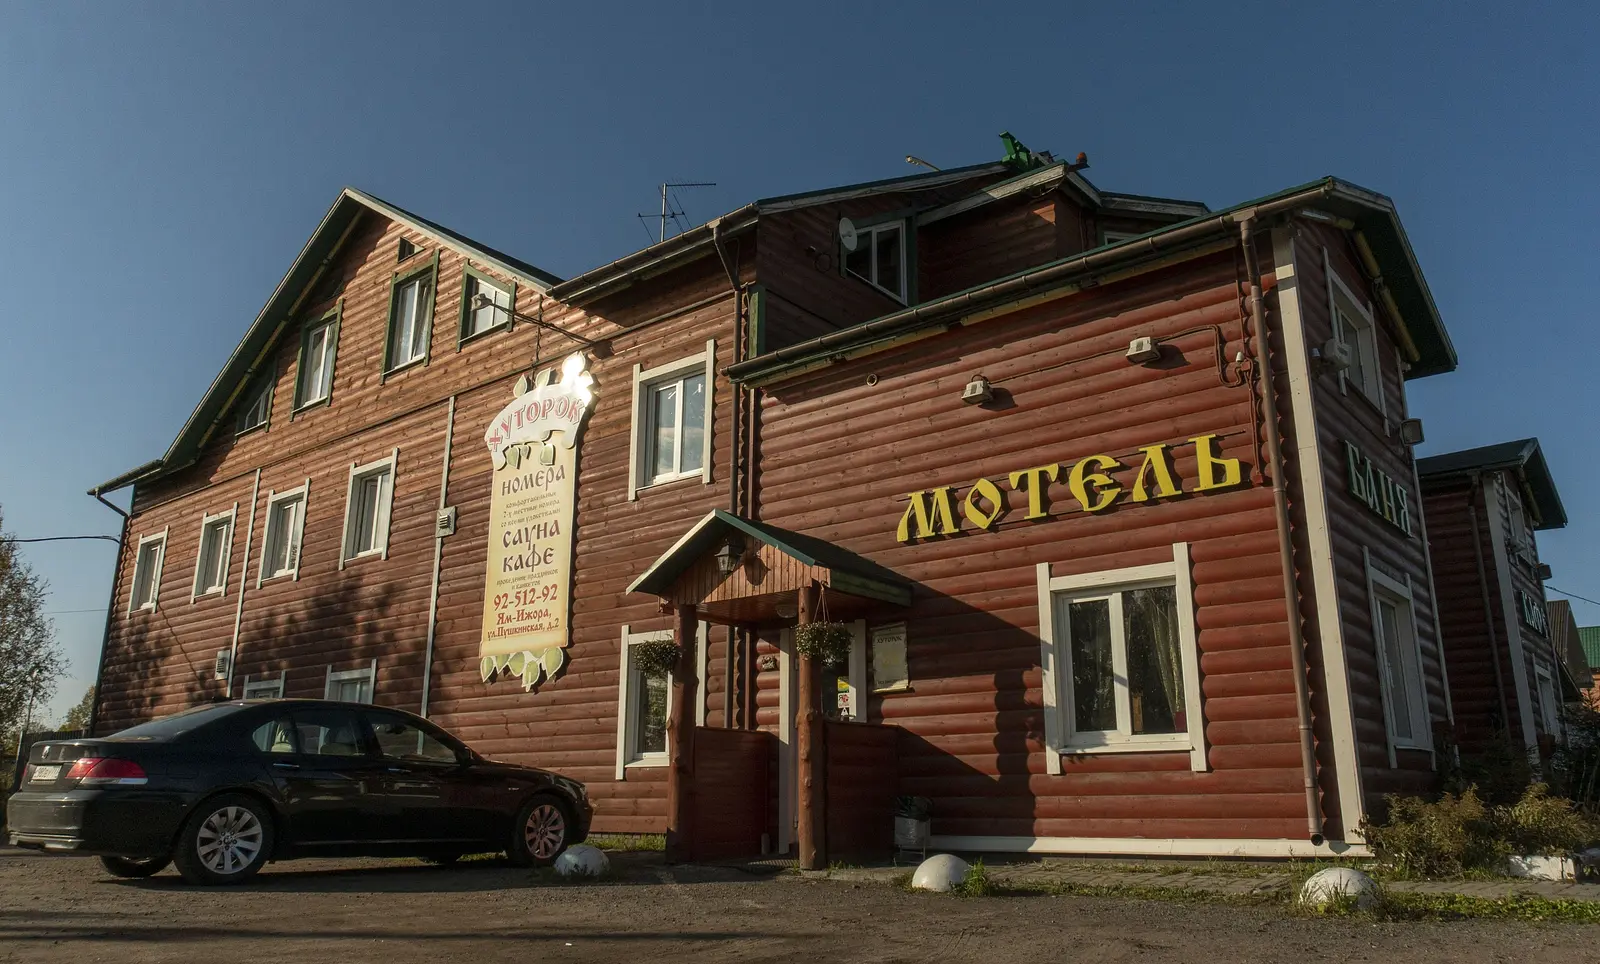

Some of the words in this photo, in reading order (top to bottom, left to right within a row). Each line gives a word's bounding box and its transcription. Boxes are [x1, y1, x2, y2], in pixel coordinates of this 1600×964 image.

[489, 397, 585, 453] ХУТОРОК
[896, 433, 1242, 543] МОТЕЛЬ
[1344, 439, 1415, 538] БАНЯ
[493, 583, 558, 611] 92-512-92
[496, 608, 552, 626] Ям-Ижора,
